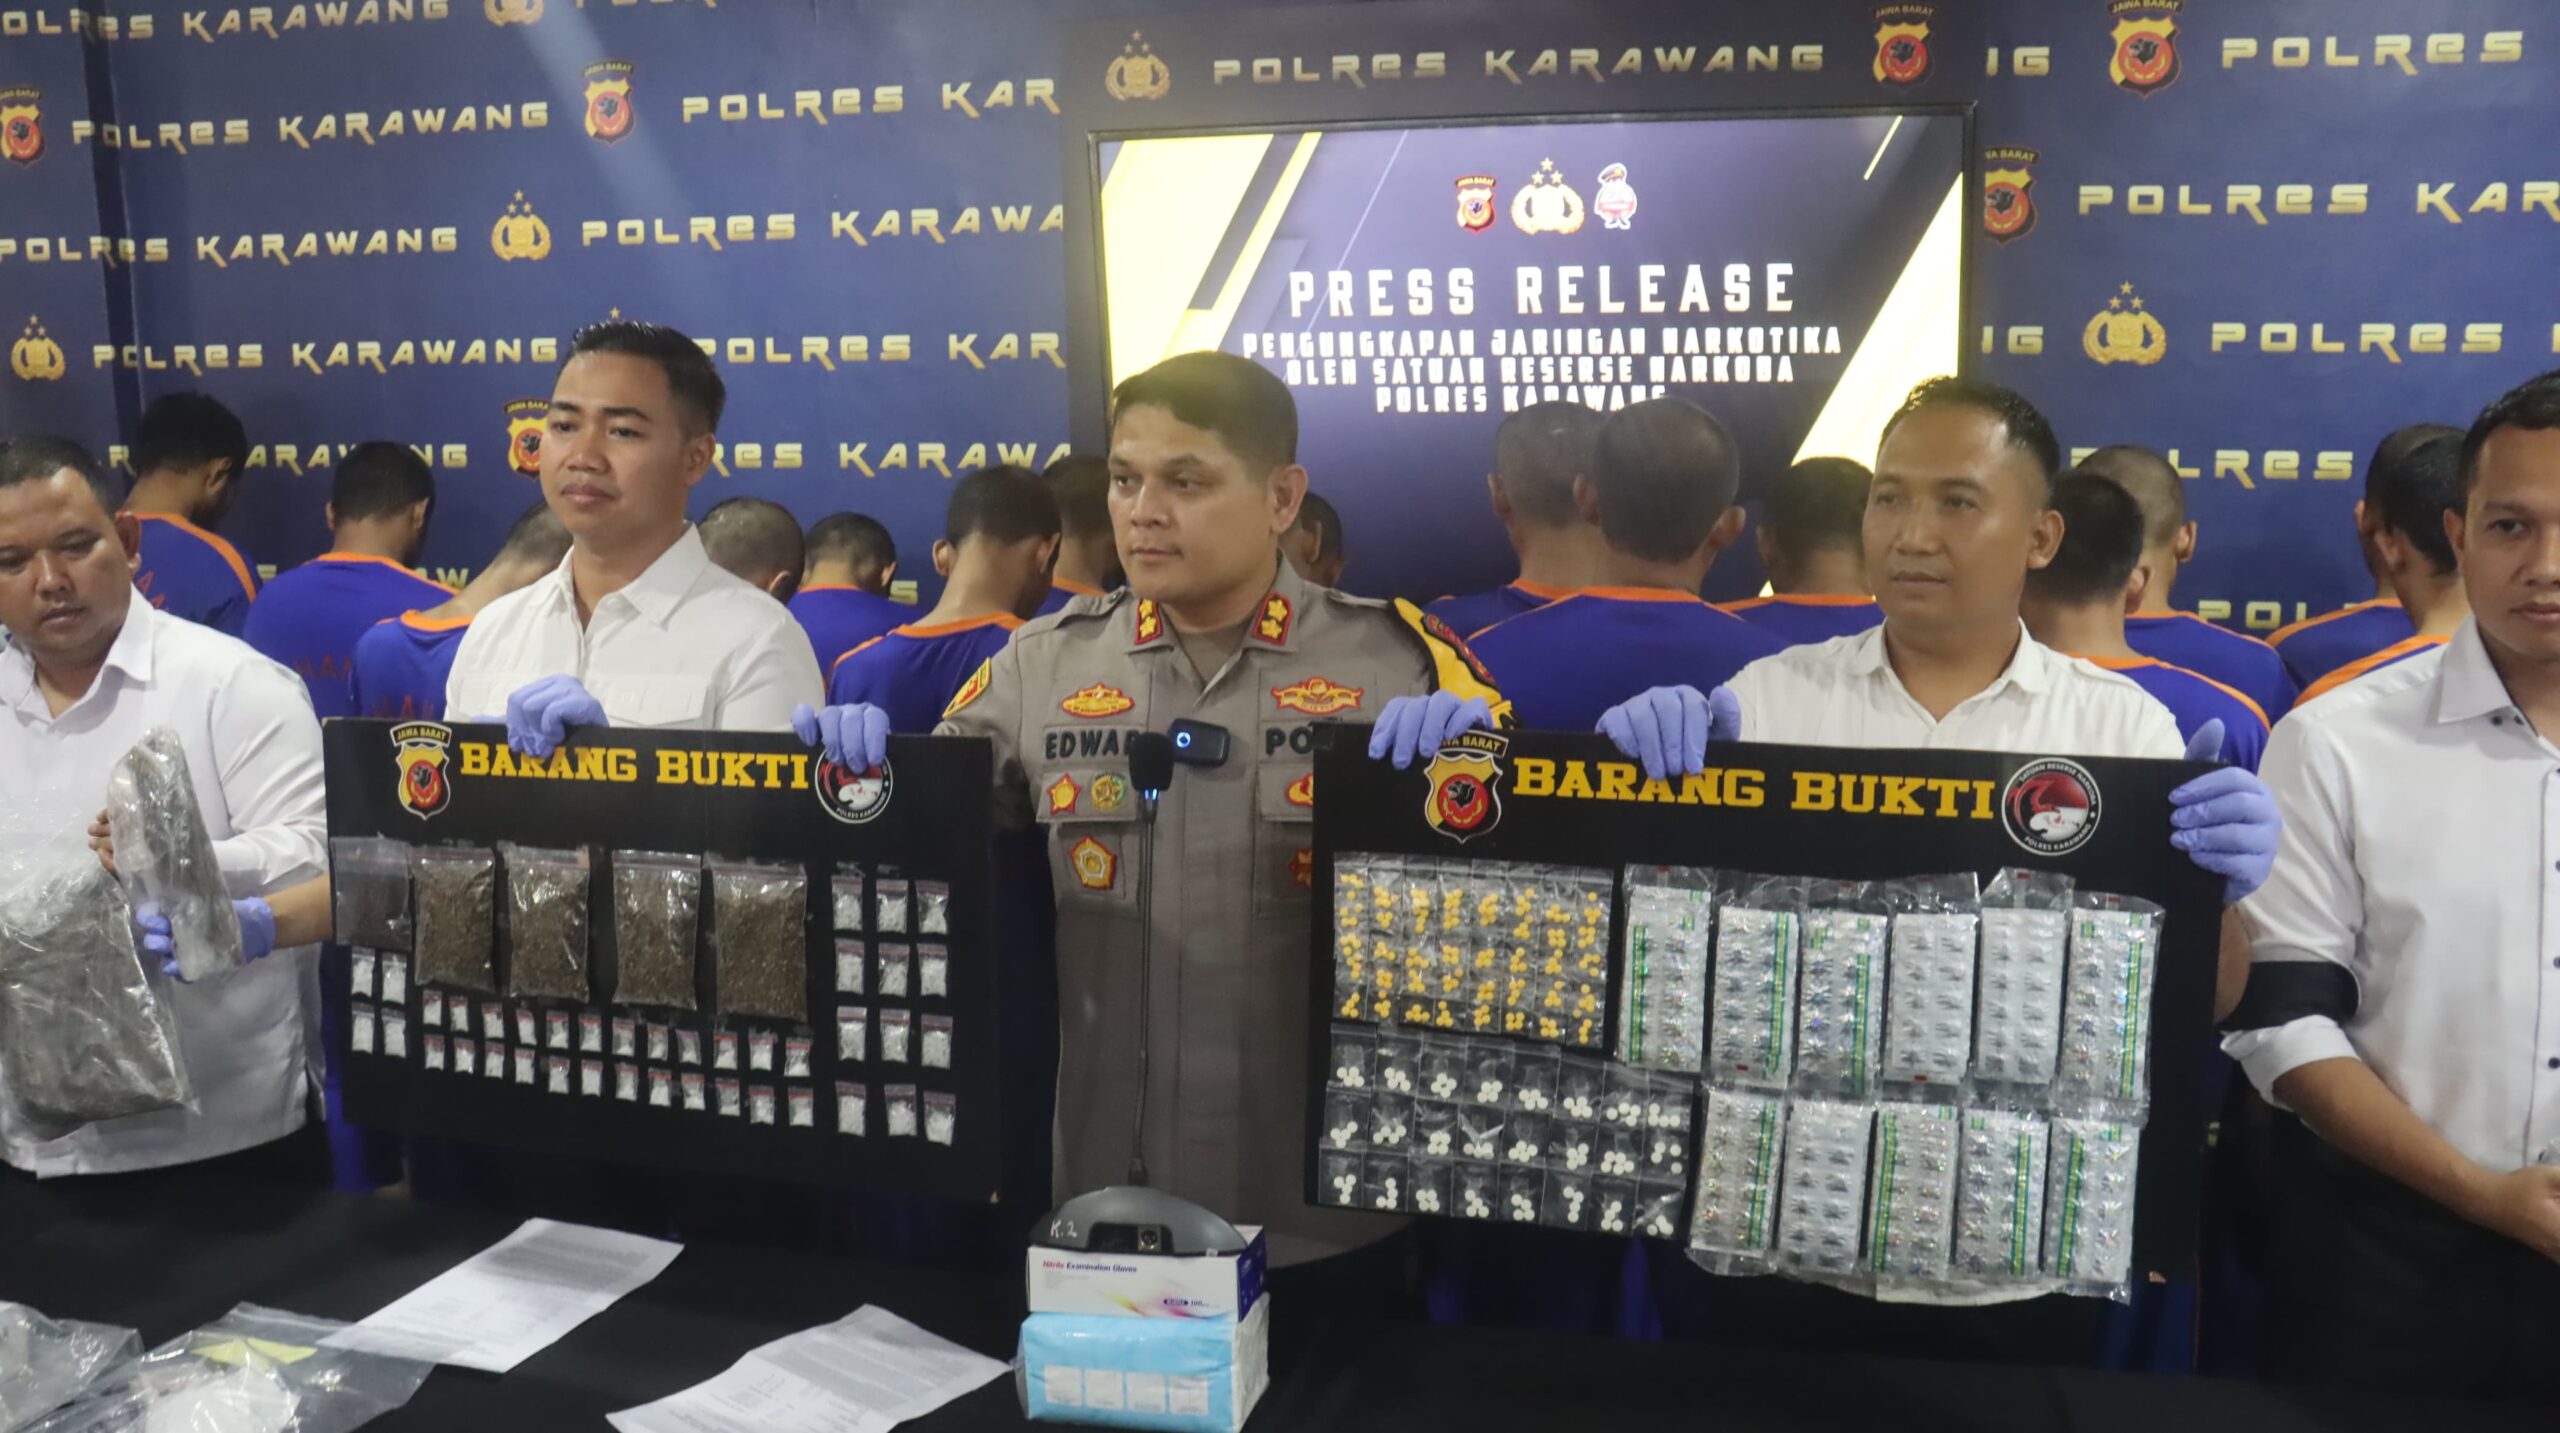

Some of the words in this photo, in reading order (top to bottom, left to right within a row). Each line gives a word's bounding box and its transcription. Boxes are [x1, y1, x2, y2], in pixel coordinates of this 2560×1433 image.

[183, 0, 449, 43] KARAWANG
[1485, 46, 1824, 85] KARAWANG
[279, 102, 549, 148] KARAWANG
[197, 227, 458, 268] KARAWANG
[1290, 267, 1475, 317] PRESS
[1517, 264, 1794, 315] RELEASE
[291, 338, 557, 374] KARAWANG
[1242, 330, 1475, 358] PENGUNGKAPAN
[1491, 328, 1645, 355] JARINGAN
[1662, 327, 1841, 354] NARKOTIKA
[1373, 357, 1485, 385] SATUAN
[1500, 356, 1633, 384] RESERSE
[1650, 355, 1794, 383] NARKOBA
[1376, 386, 1487, 413] POLRES
[656, 749, 809, 789] BUKTI
[1513, 757, 1764, 808] BARANG
[1791, 771, 1995, 819] BUKTI
[1066, 1262, 1111, 1272] Examination
